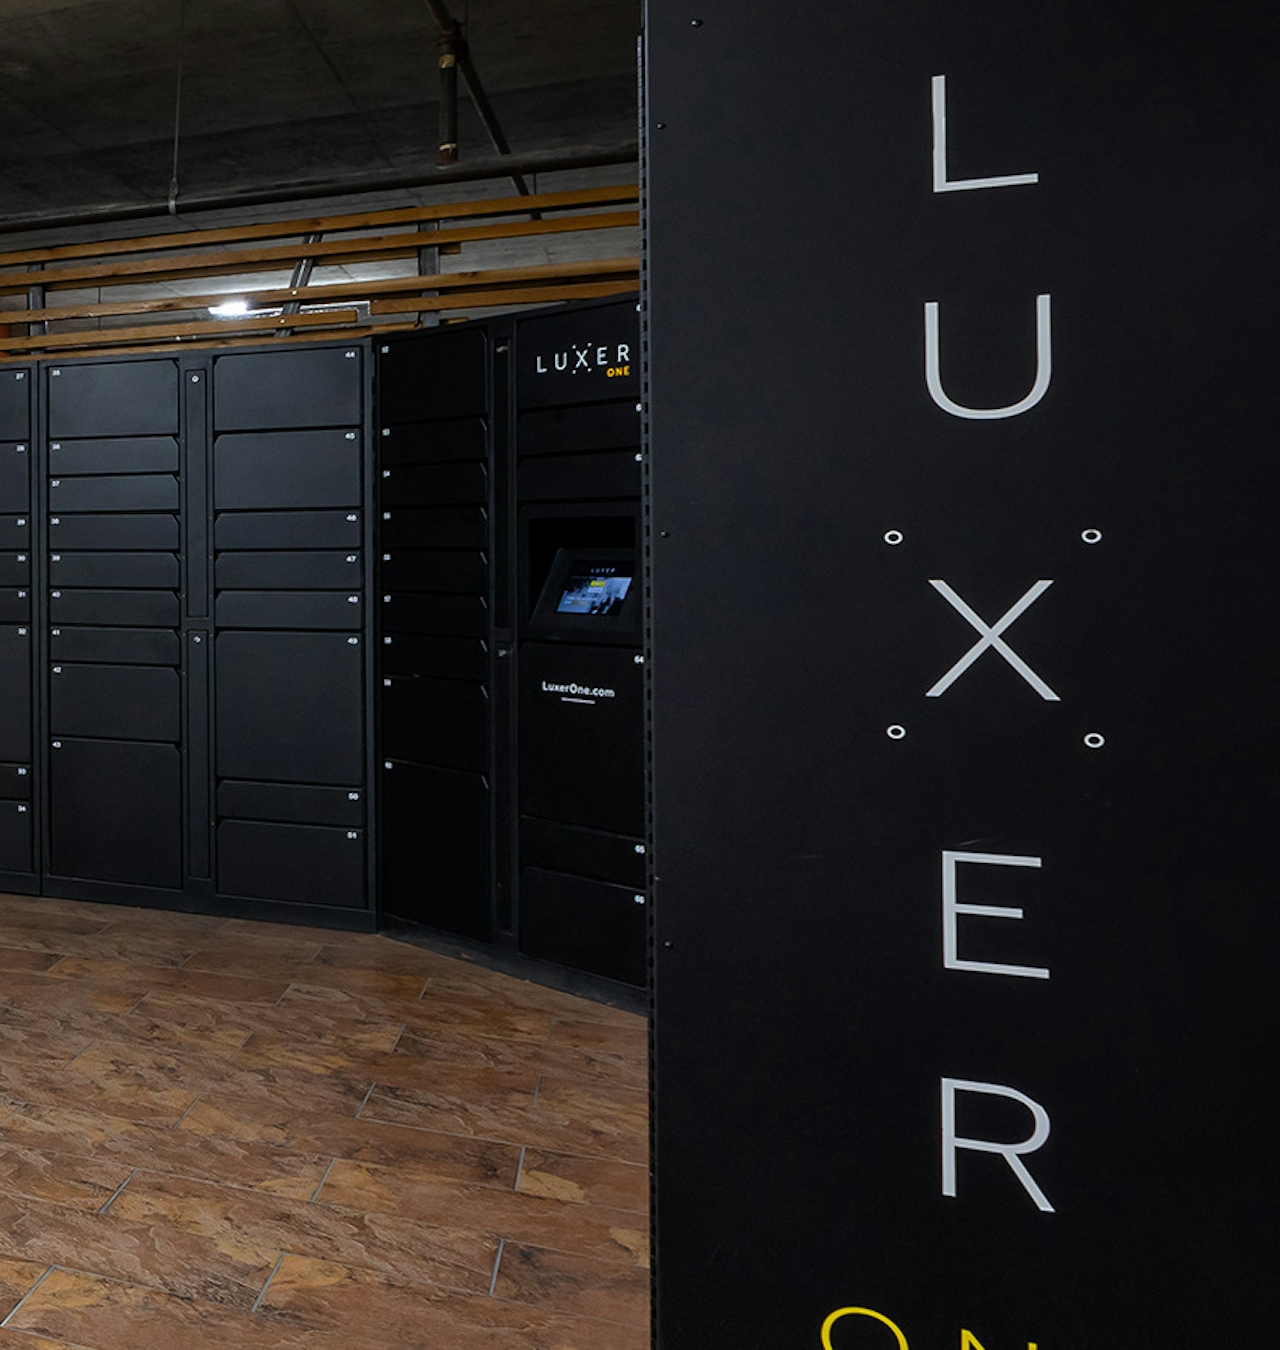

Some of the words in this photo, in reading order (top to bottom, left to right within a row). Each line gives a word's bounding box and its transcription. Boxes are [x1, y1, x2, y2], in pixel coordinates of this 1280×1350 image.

[536, 342, 631, 374] LUXER
[605, 366, 631, 378] ONE
[923, 72, 1062, 1214] LUXER
[541, 680, 616, 698] LuxerOne.com
